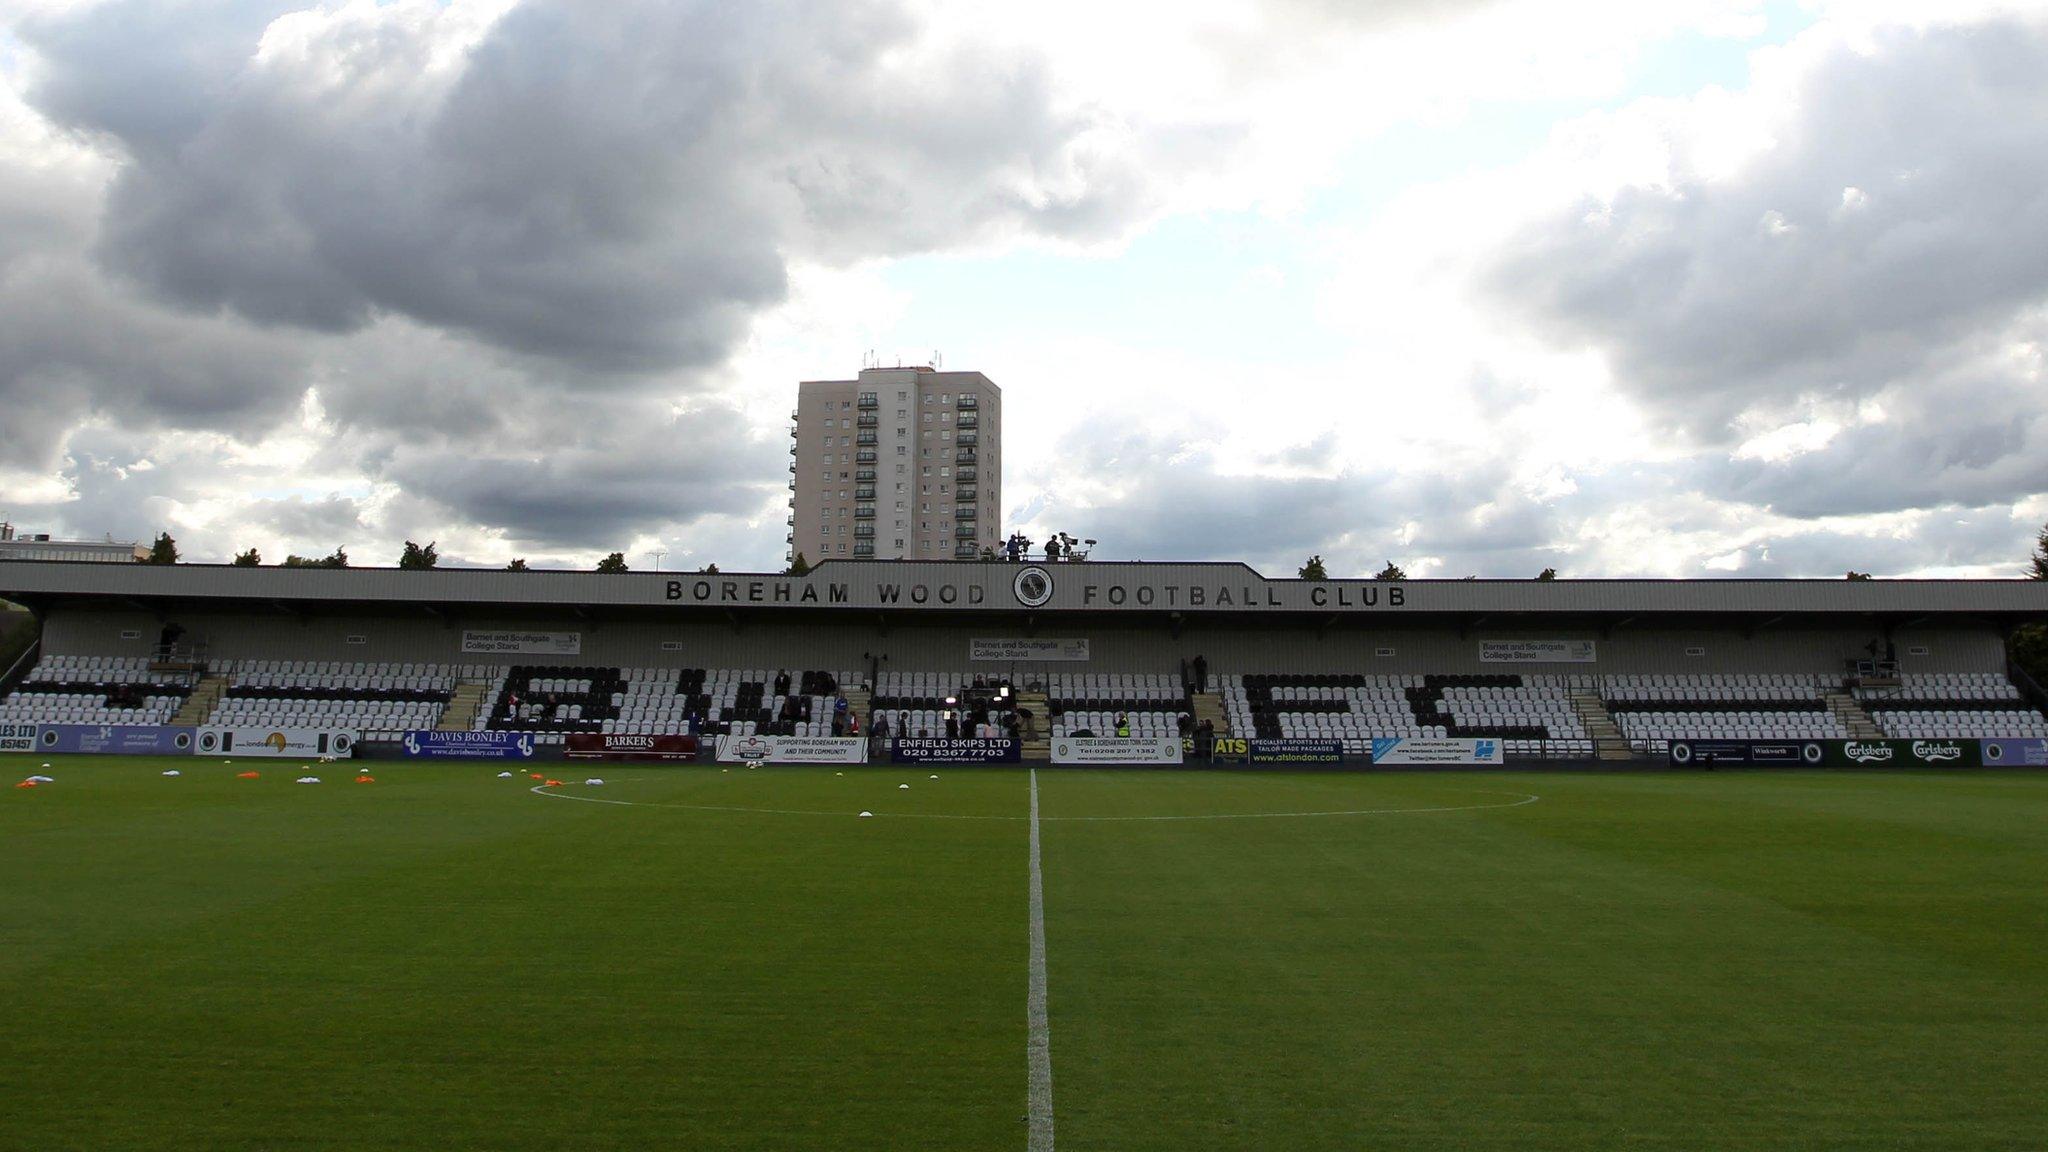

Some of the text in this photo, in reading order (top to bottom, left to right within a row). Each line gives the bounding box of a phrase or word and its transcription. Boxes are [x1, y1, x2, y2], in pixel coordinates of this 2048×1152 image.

[666, 581, 1405, 606] BOREHAM WOOD FOOTBALL CLUB
[466, 633, 550, 644] Barnet and Southgate
[466, 642, 520, 652] College Stand
[974, 640, 1000, 648] Barnet
[1018, 641, 1057, 651] Southgate
[1483, 643, 1566, 653] Barnet and Southgate
[974, 650, 1004, 660] College
[1483, 652, 1513, 662] College
[18, 725, 36, 737] LTD
[430, 732, 509, 743] DAVIS BONLEY
[605, 736, 655, 748] BARKERS
[899, 739, 1011, 748] ENFIELD SKIPS LTD
[1214, 739, 1247, 754] ATS
[1754, 747, 1787, 755] Winkworth
[1845, 741, 1893, 762] Carlsberg
[1912, 740, 1961, 761] Carlsberg
[1253, 754, 1340, 762] www.atslondon.com
